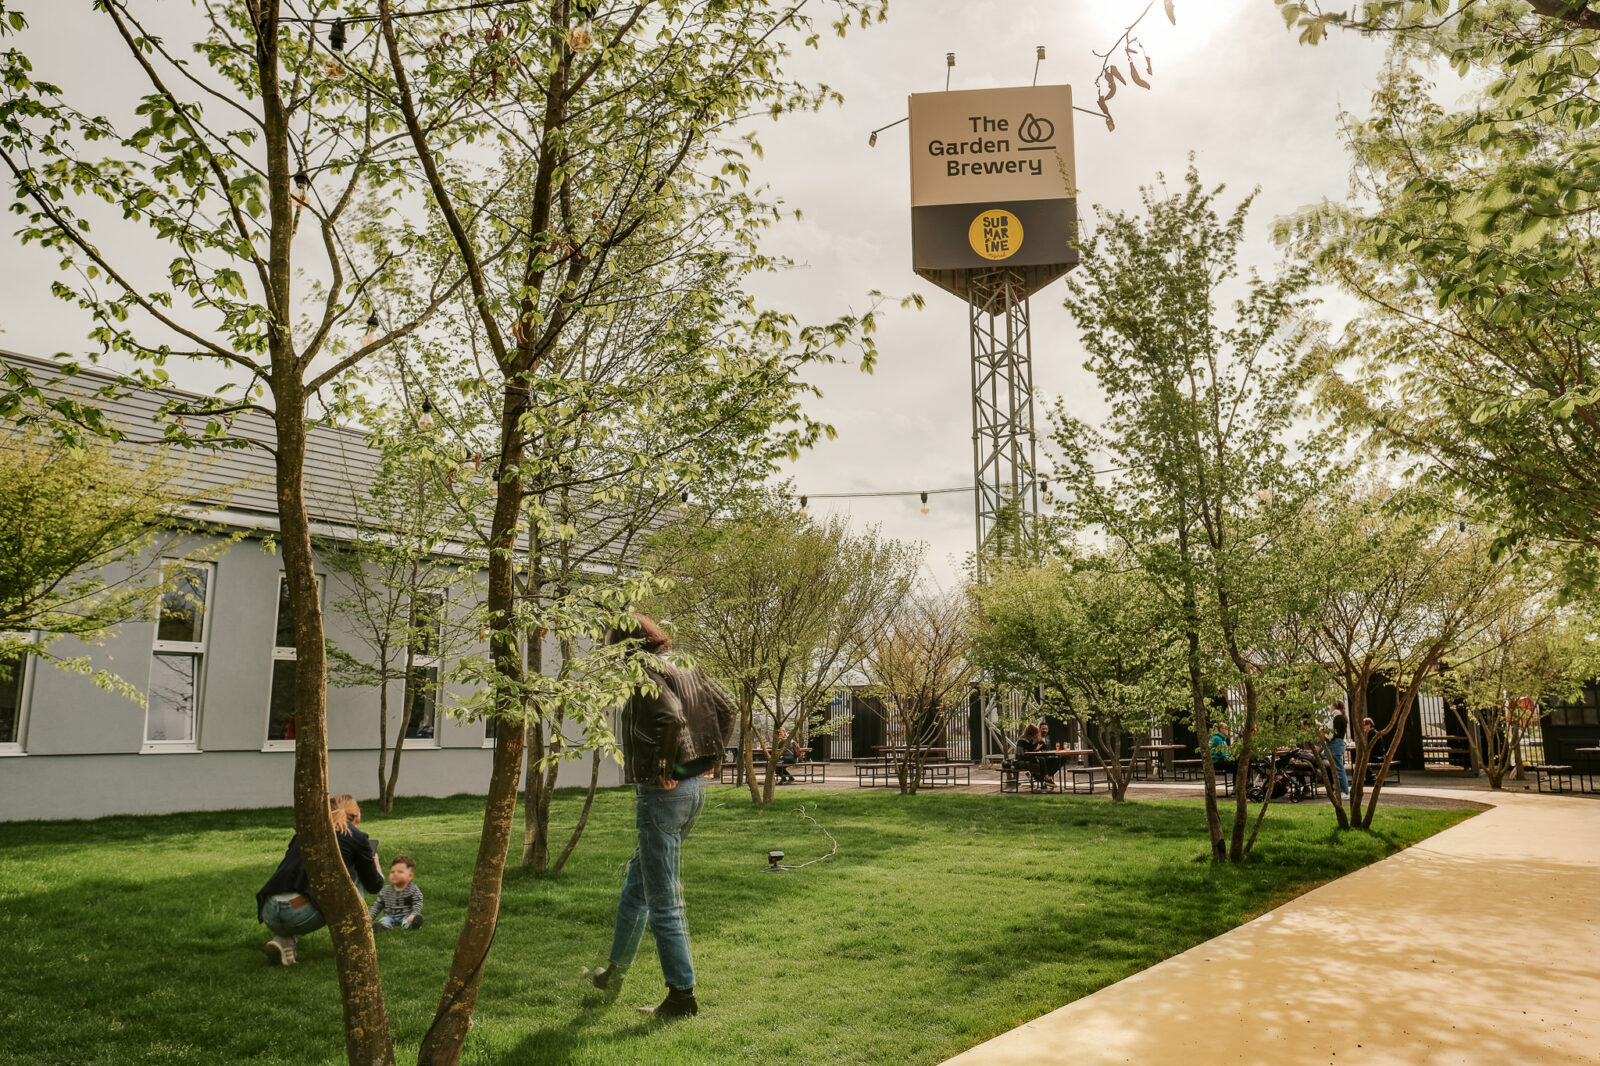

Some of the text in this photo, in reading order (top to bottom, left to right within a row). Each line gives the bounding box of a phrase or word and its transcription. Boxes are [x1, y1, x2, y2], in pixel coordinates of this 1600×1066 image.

[968, 116, 1009, 133] The
[928, 137, 1010, 156] Garden
[946, 159, 1042, 176] Brewery
[983, 216, 1009, 228] SUB
[983, 227, 1009, 240] MAR
